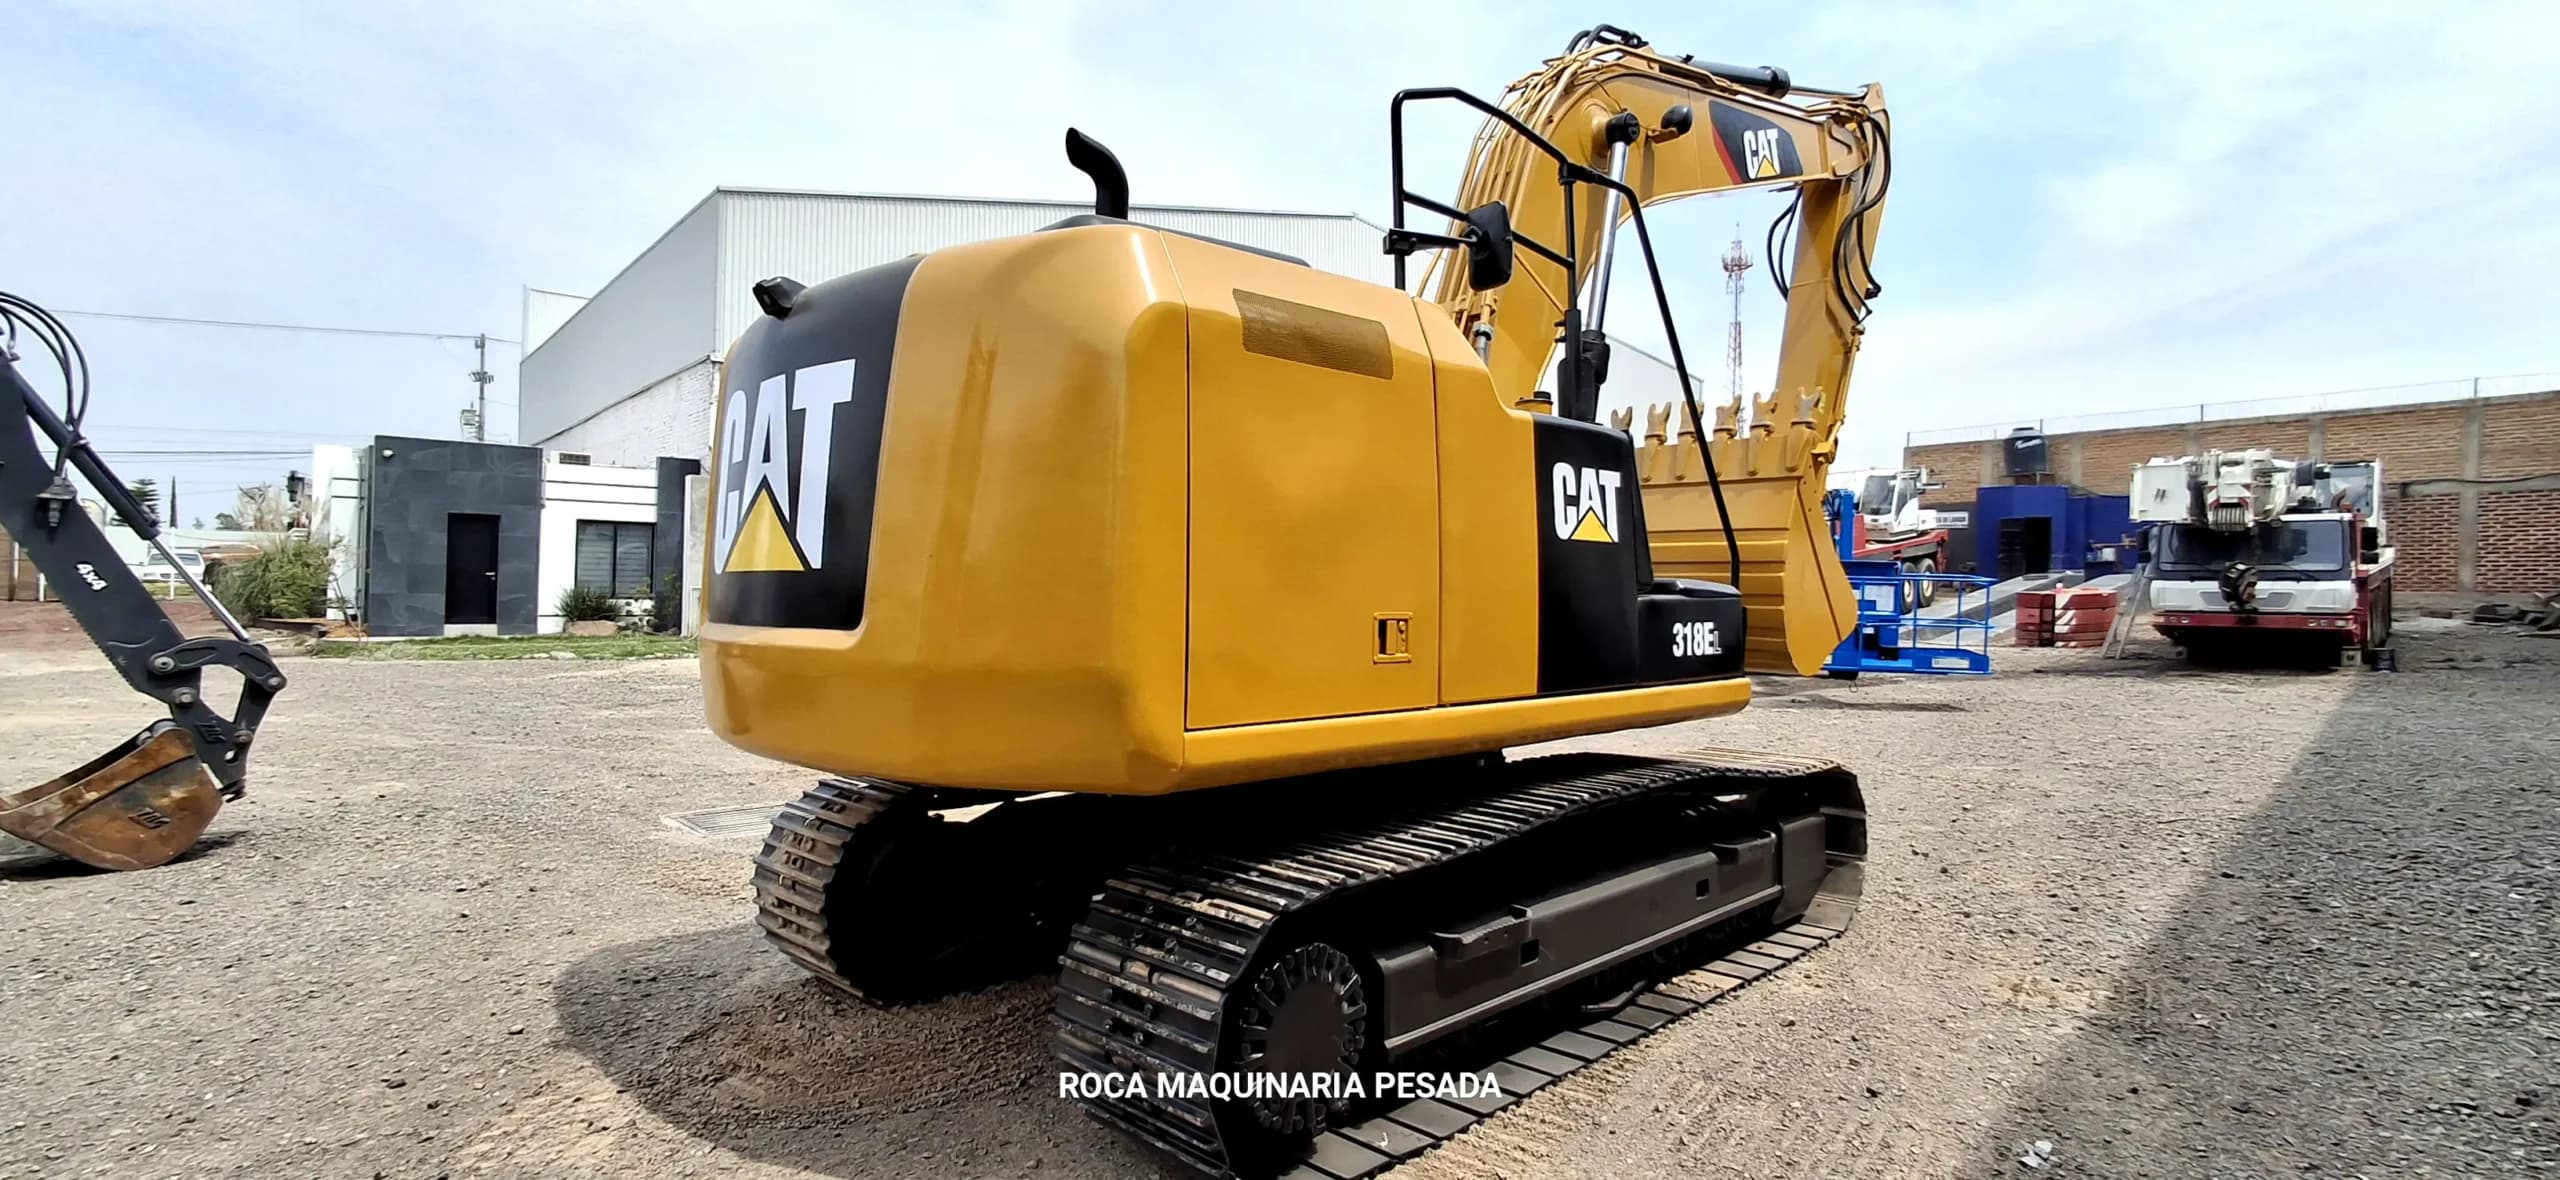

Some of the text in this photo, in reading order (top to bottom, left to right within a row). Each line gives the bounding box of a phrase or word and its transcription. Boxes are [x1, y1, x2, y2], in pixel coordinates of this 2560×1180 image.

[1743, 128, 1780, 179] CAT
[714, 359, 856, 575] CAT
[1553, 462, 1621, 543] CAT
